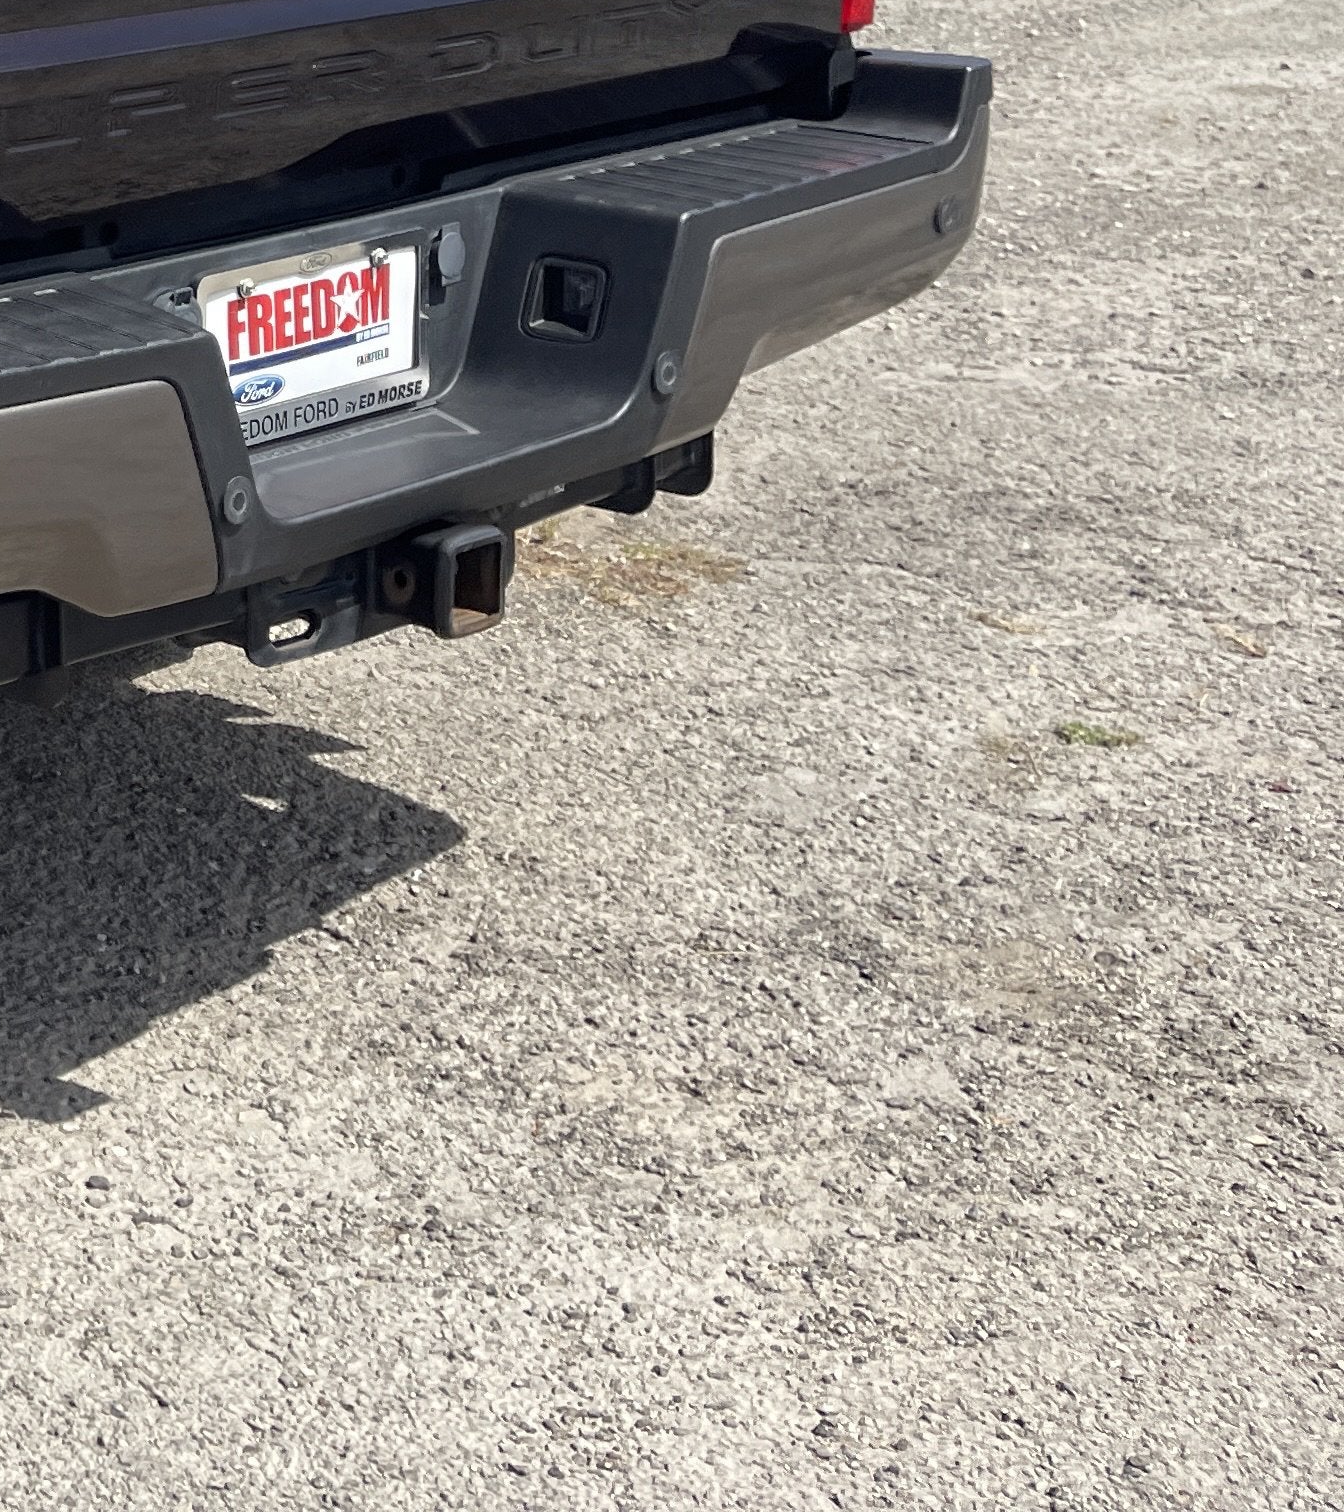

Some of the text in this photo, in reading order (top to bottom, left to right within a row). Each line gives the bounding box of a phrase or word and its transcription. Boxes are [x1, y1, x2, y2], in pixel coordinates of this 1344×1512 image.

[227, 263, 390, 361] FREEDOM
[240, 410, 288, 440] EDOM
[294, 397, 339, 428] FORD
[359, 392, 375, 410] ED
[377, 379, 423, 405] MORSE
[241, 378, 275, 403] Ford
